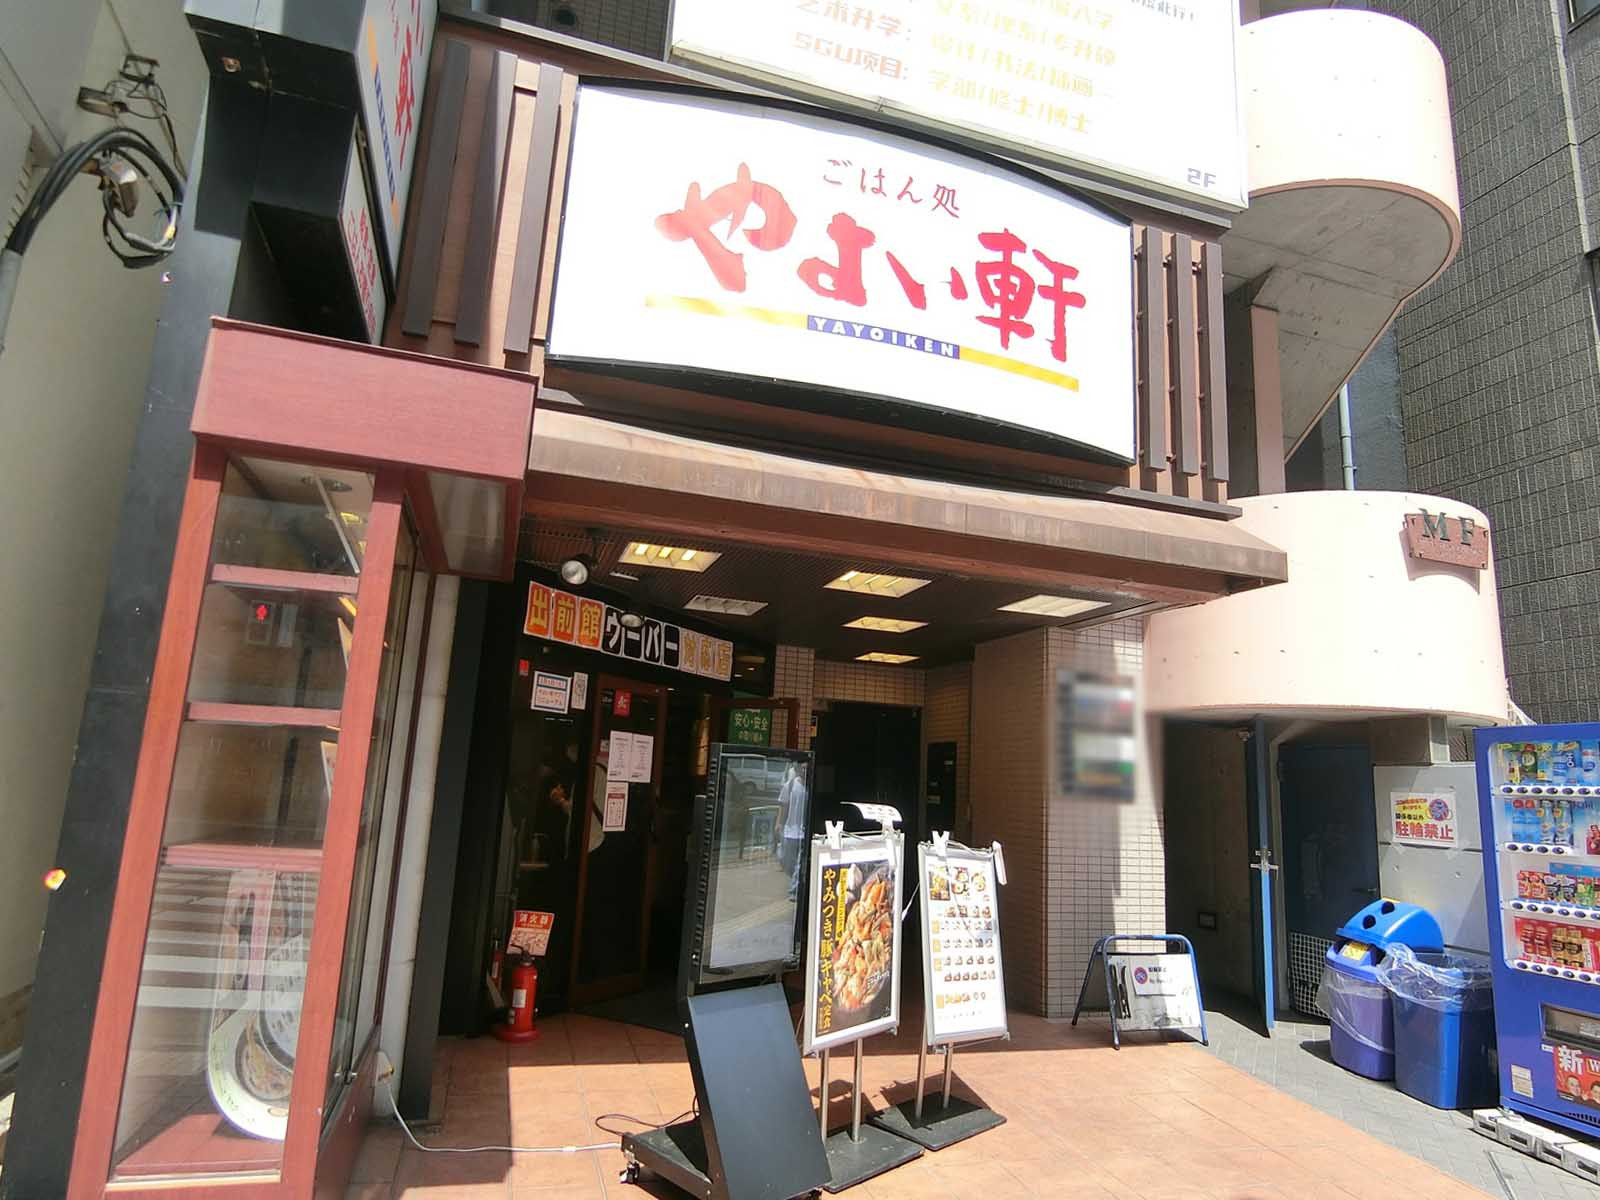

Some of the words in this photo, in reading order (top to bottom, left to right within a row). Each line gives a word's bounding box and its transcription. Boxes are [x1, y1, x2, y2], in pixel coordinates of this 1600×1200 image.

[823, 158, 961, 219] ごはん処
[1187, 167, 1217, 189] 2F
[653, 162, 1087, 362] やよい軒
[812, 317, 955, 358] YAYOIKEN
[1395, 821, 1454, 840] 駐輪禁止
[1558, 1044, 1584, 1076] 新
